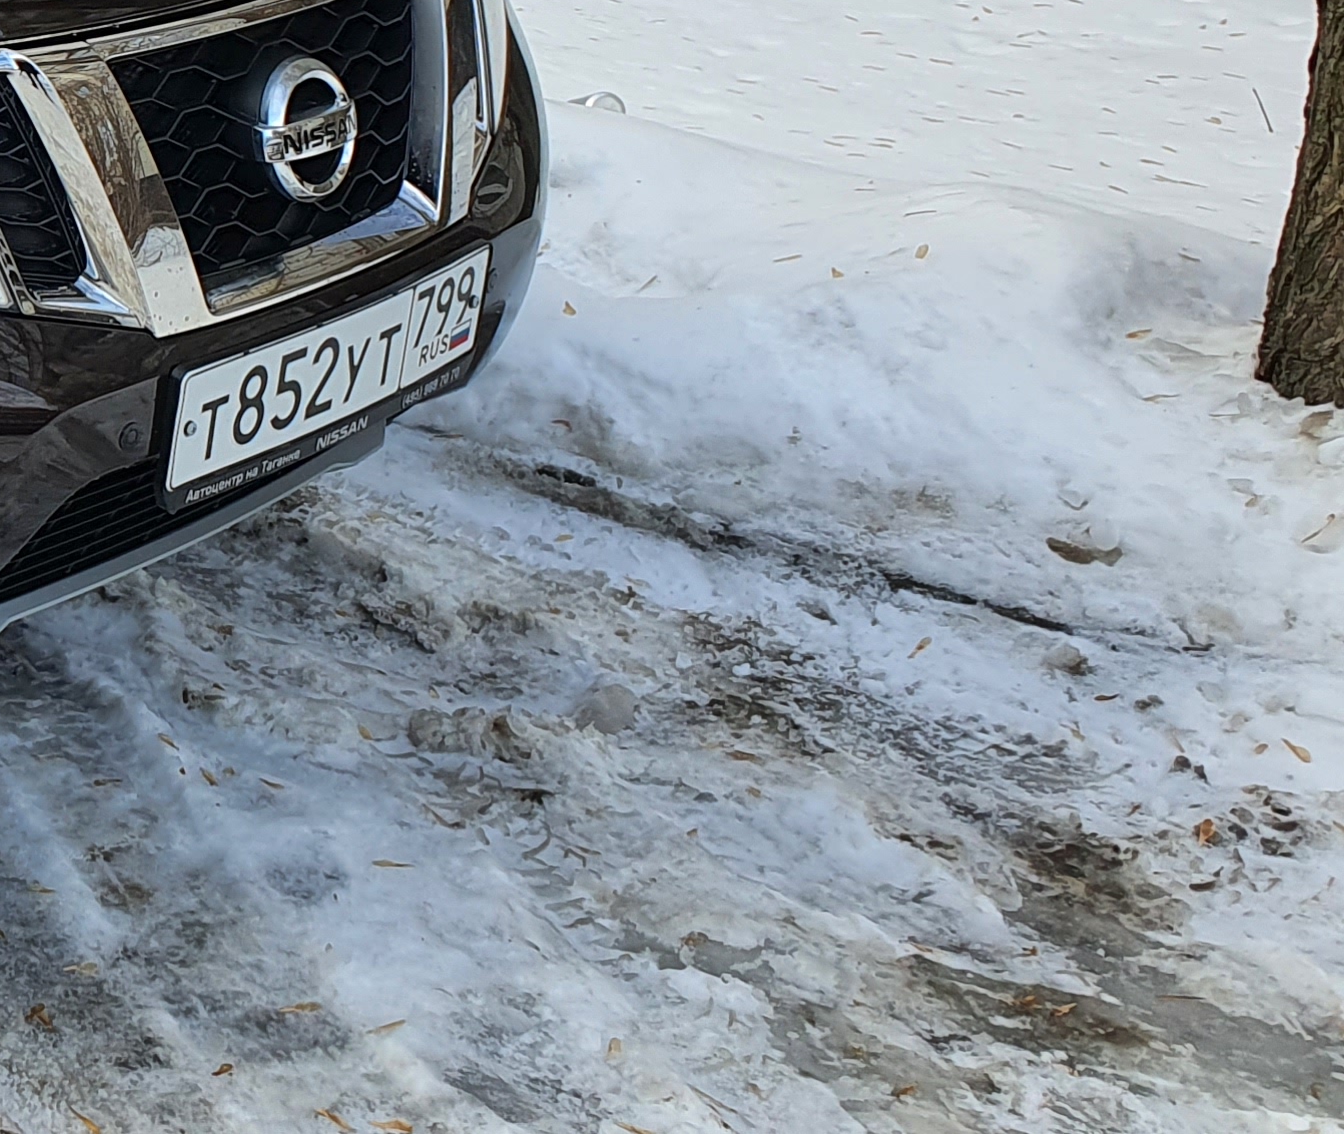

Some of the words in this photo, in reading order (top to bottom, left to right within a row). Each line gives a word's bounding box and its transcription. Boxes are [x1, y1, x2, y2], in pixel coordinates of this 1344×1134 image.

[283, 114, 356, 154] NISSAN
[413, 266, 475, 350] 799
[418, 333, 449, 367] RUS
[315, 415, 368, 451] NISSAN
[185, 473, 244, 504] Автоцентр
[245, 466, 259, 481] на
